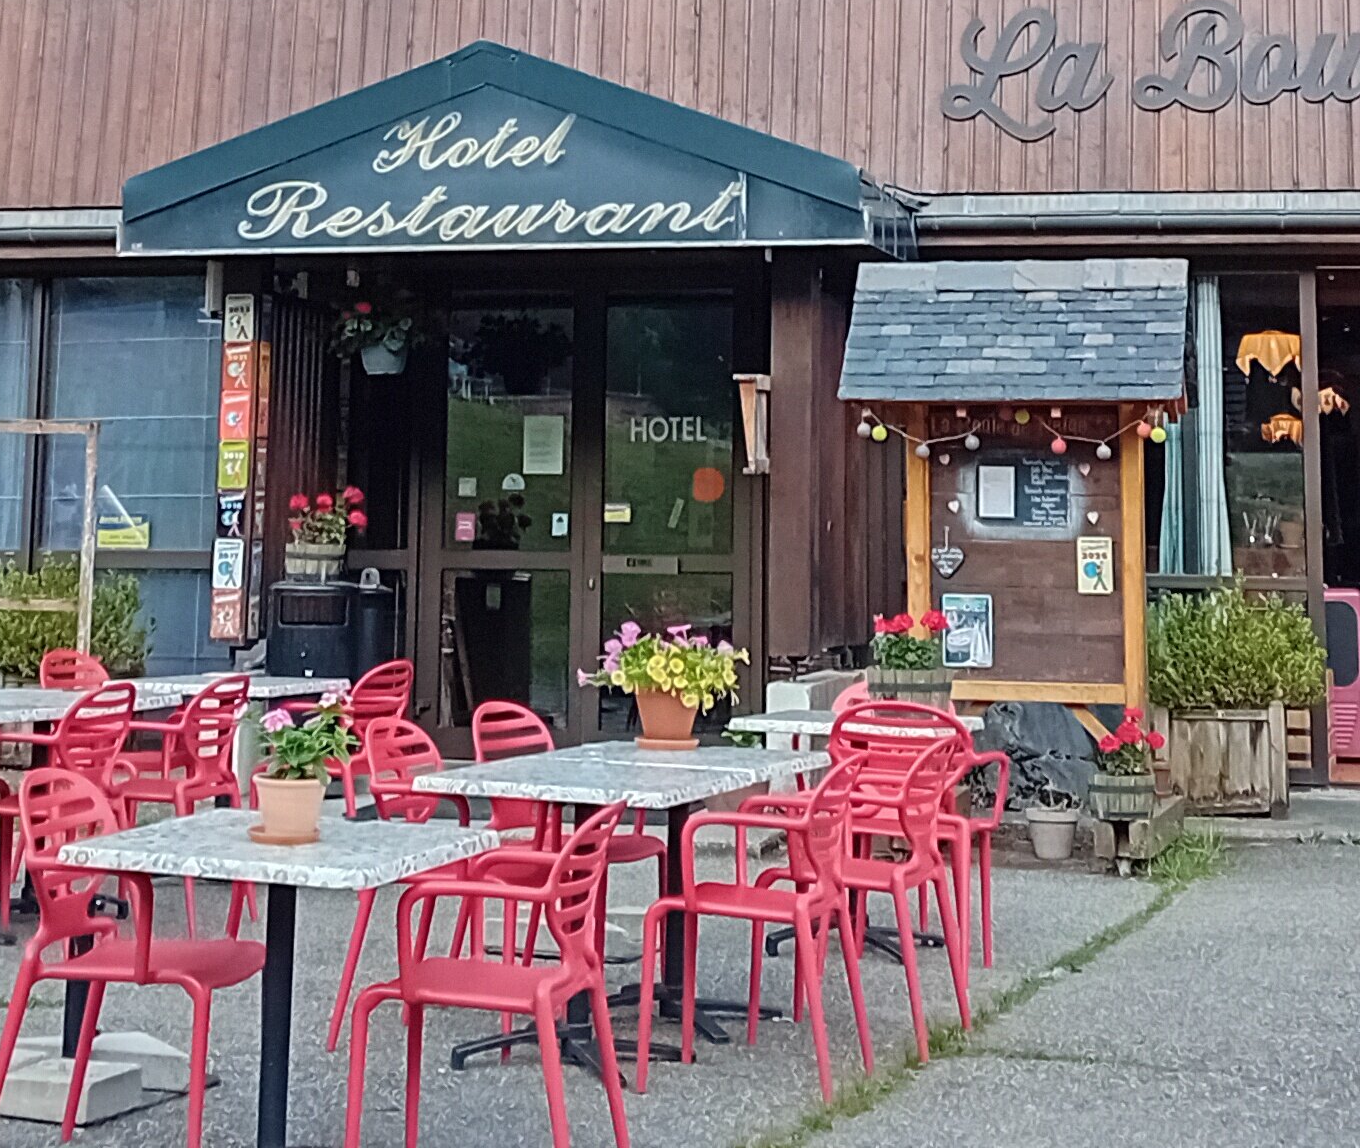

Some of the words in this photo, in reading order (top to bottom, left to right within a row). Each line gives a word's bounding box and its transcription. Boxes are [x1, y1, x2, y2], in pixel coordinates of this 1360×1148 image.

[939, 6, 1114, 144] La
[372, 113, 576, 174] Hotel
[237, 180, 743, 243] Restaurant
[630, 416, 707, 442] HOTEL
